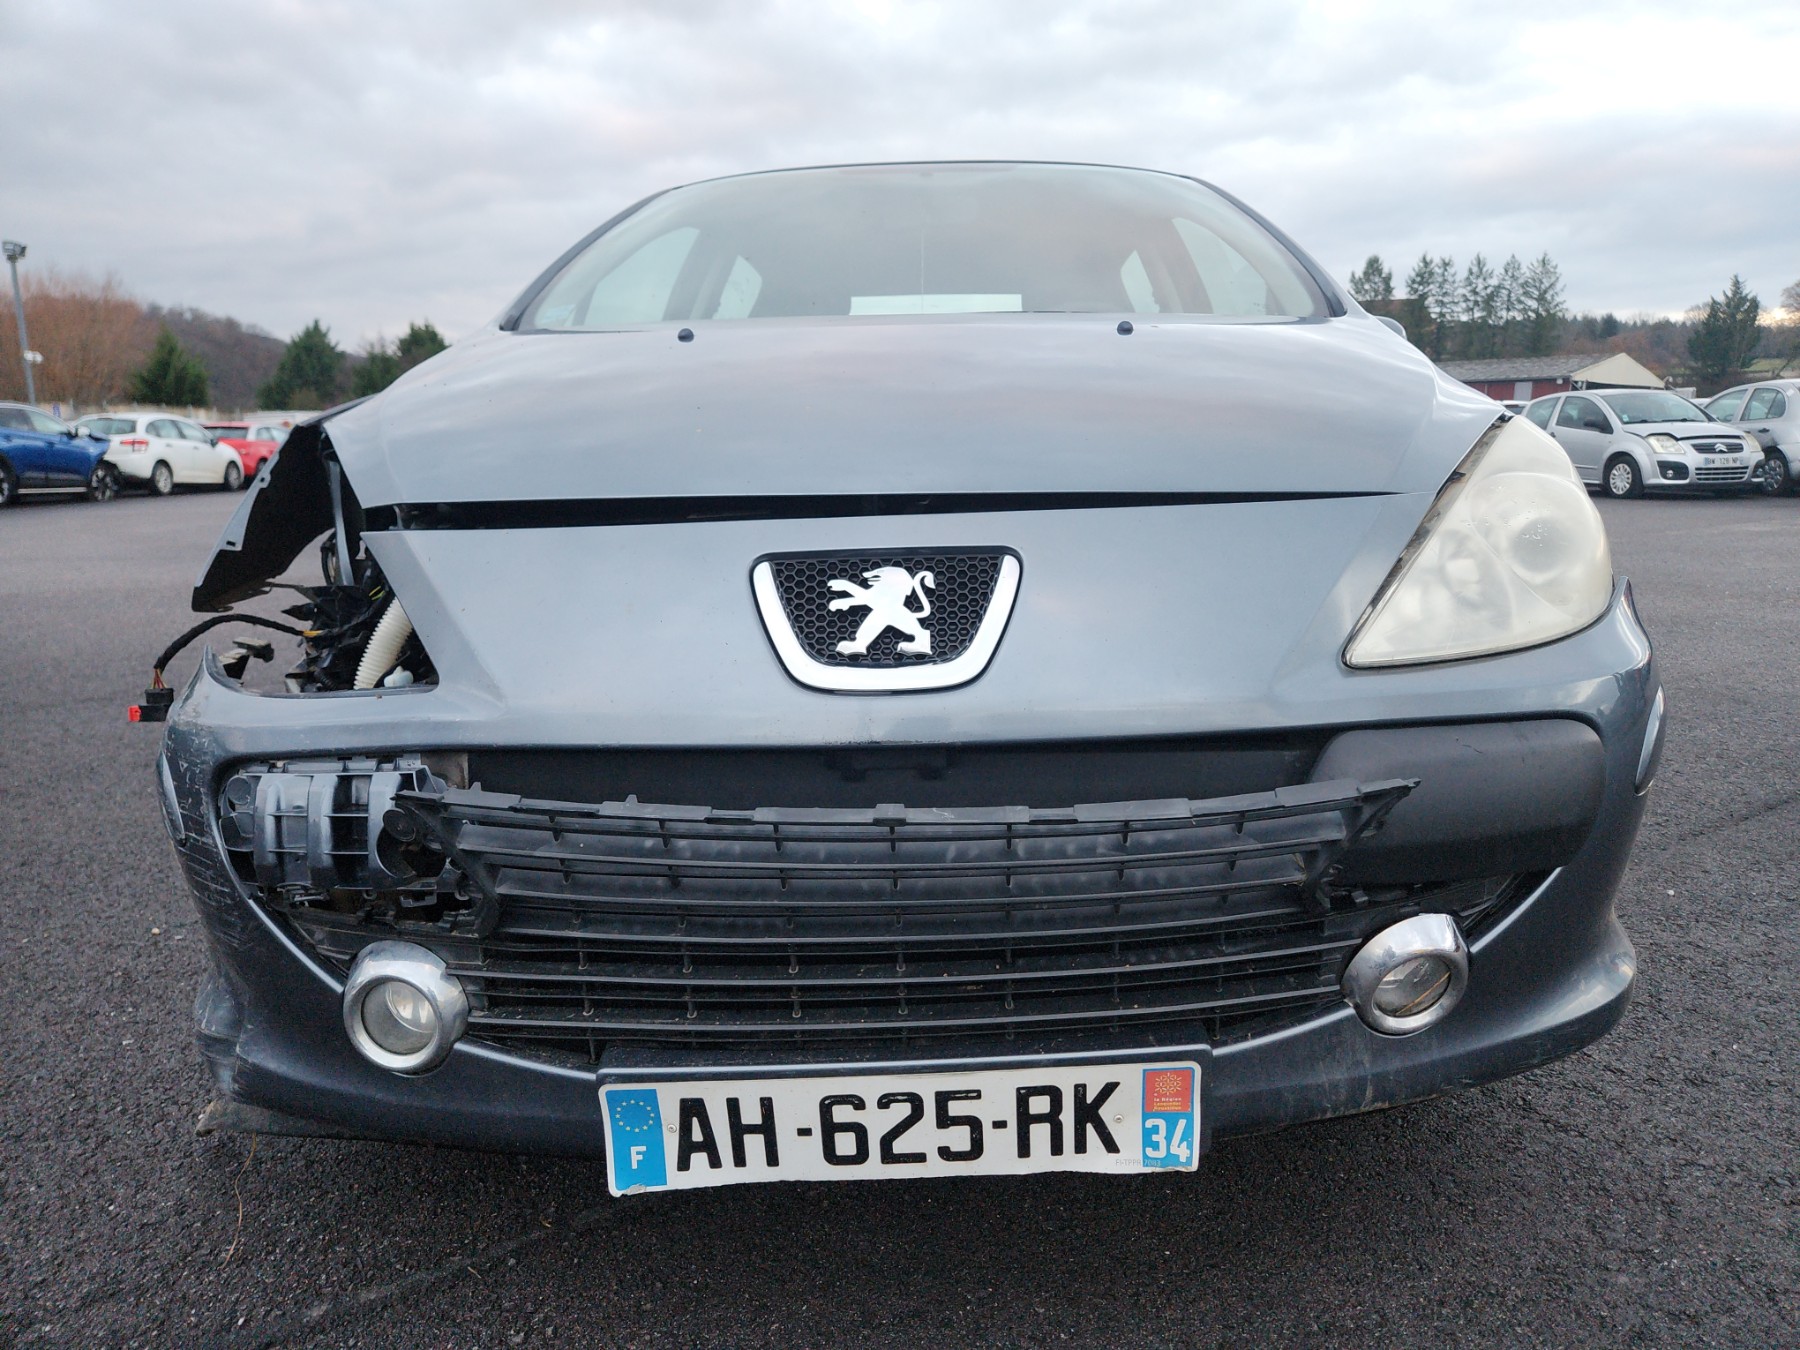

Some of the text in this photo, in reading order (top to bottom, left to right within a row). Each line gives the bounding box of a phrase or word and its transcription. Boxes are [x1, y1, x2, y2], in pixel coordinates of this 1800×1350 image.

[676, 1082, 1121, 1171] AH-625-RK
[1144, 1118, 1190, 1162] 34
[629, 1145, 647, 1170] F
